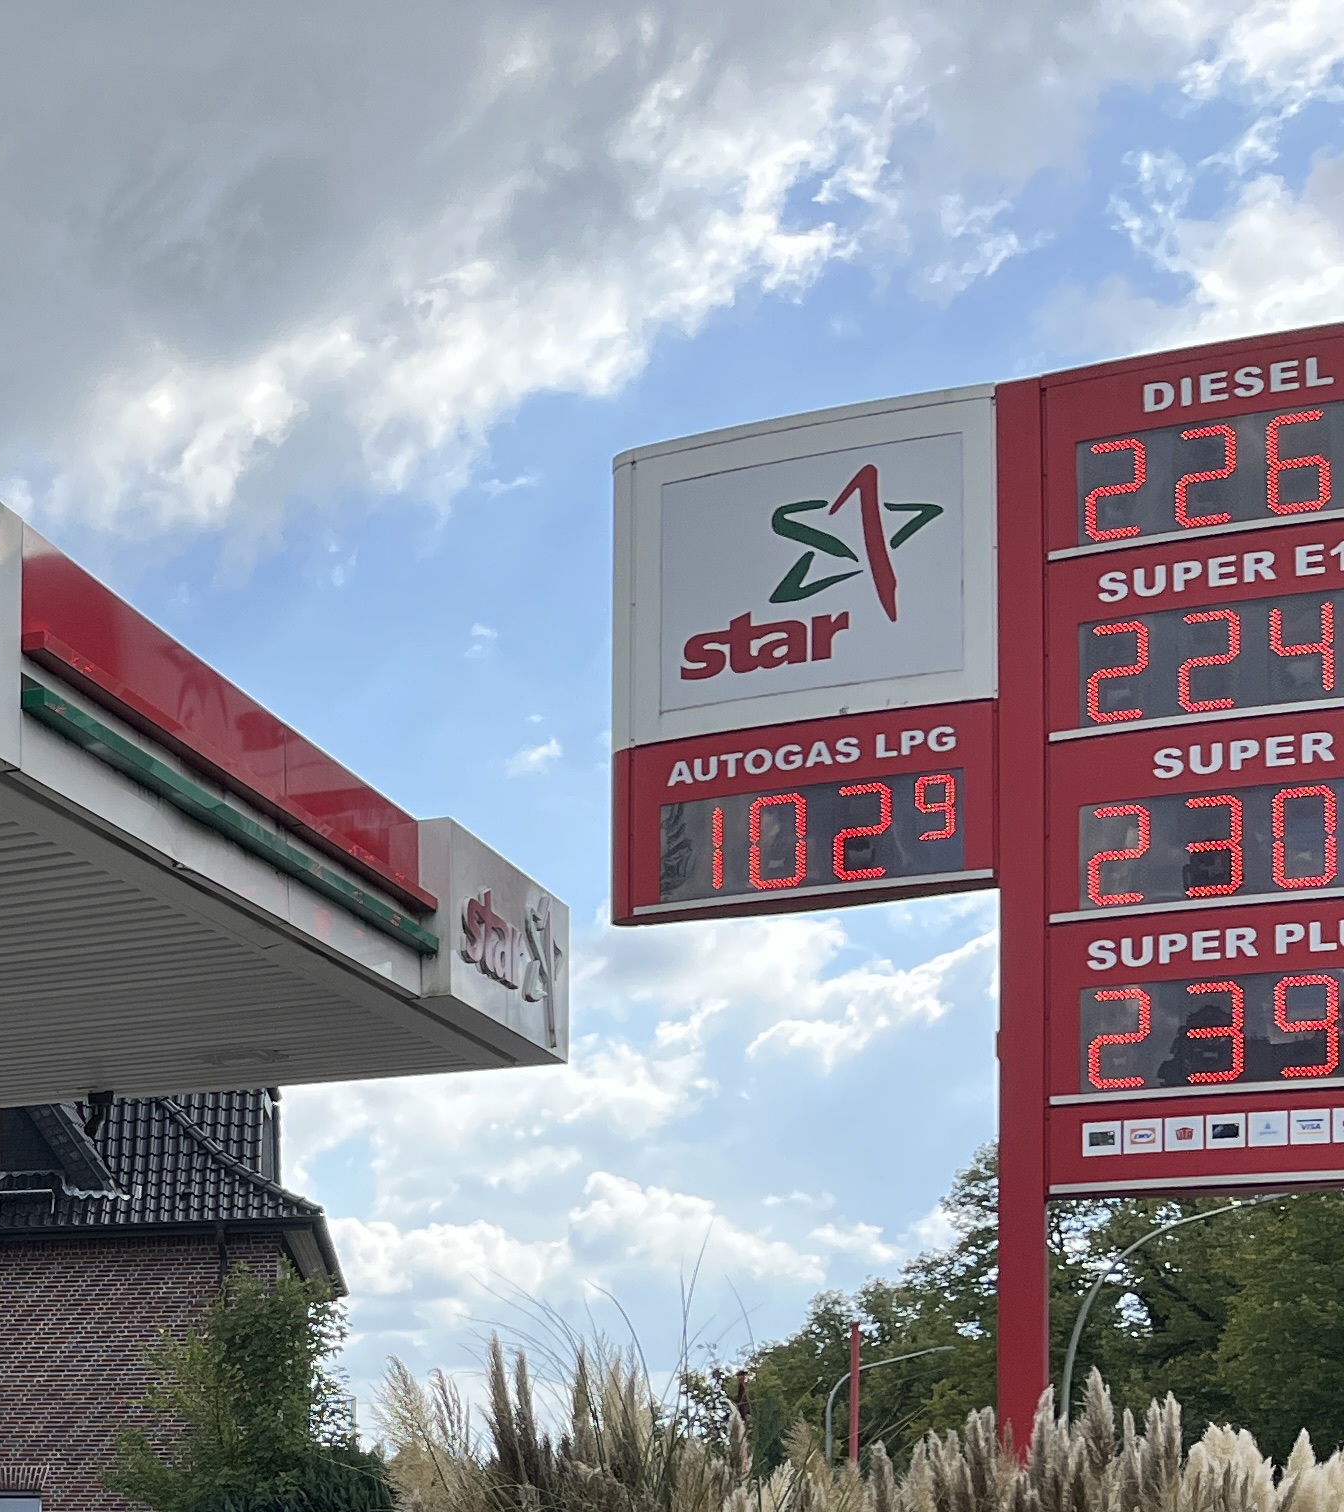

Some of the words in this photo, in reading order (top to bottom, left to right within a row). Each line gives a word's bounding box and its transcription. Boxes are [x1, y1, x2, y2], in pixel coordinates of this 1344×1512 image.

[1143, 356, 1335, 413] DIESEL
[1098, 550, 1277, 603] SUPER
[1295, 540, 1344, 577] E1
[680, 611, 850, 681] star
[667, 737, 860, 787] AUTOGAS
[875, 725, 957, 759] LPG
[1152, 731, 1335, 779] SUPER
[1087, 927, 1258, 971] SUPER
[1275, 919, 1344, 955] PL
